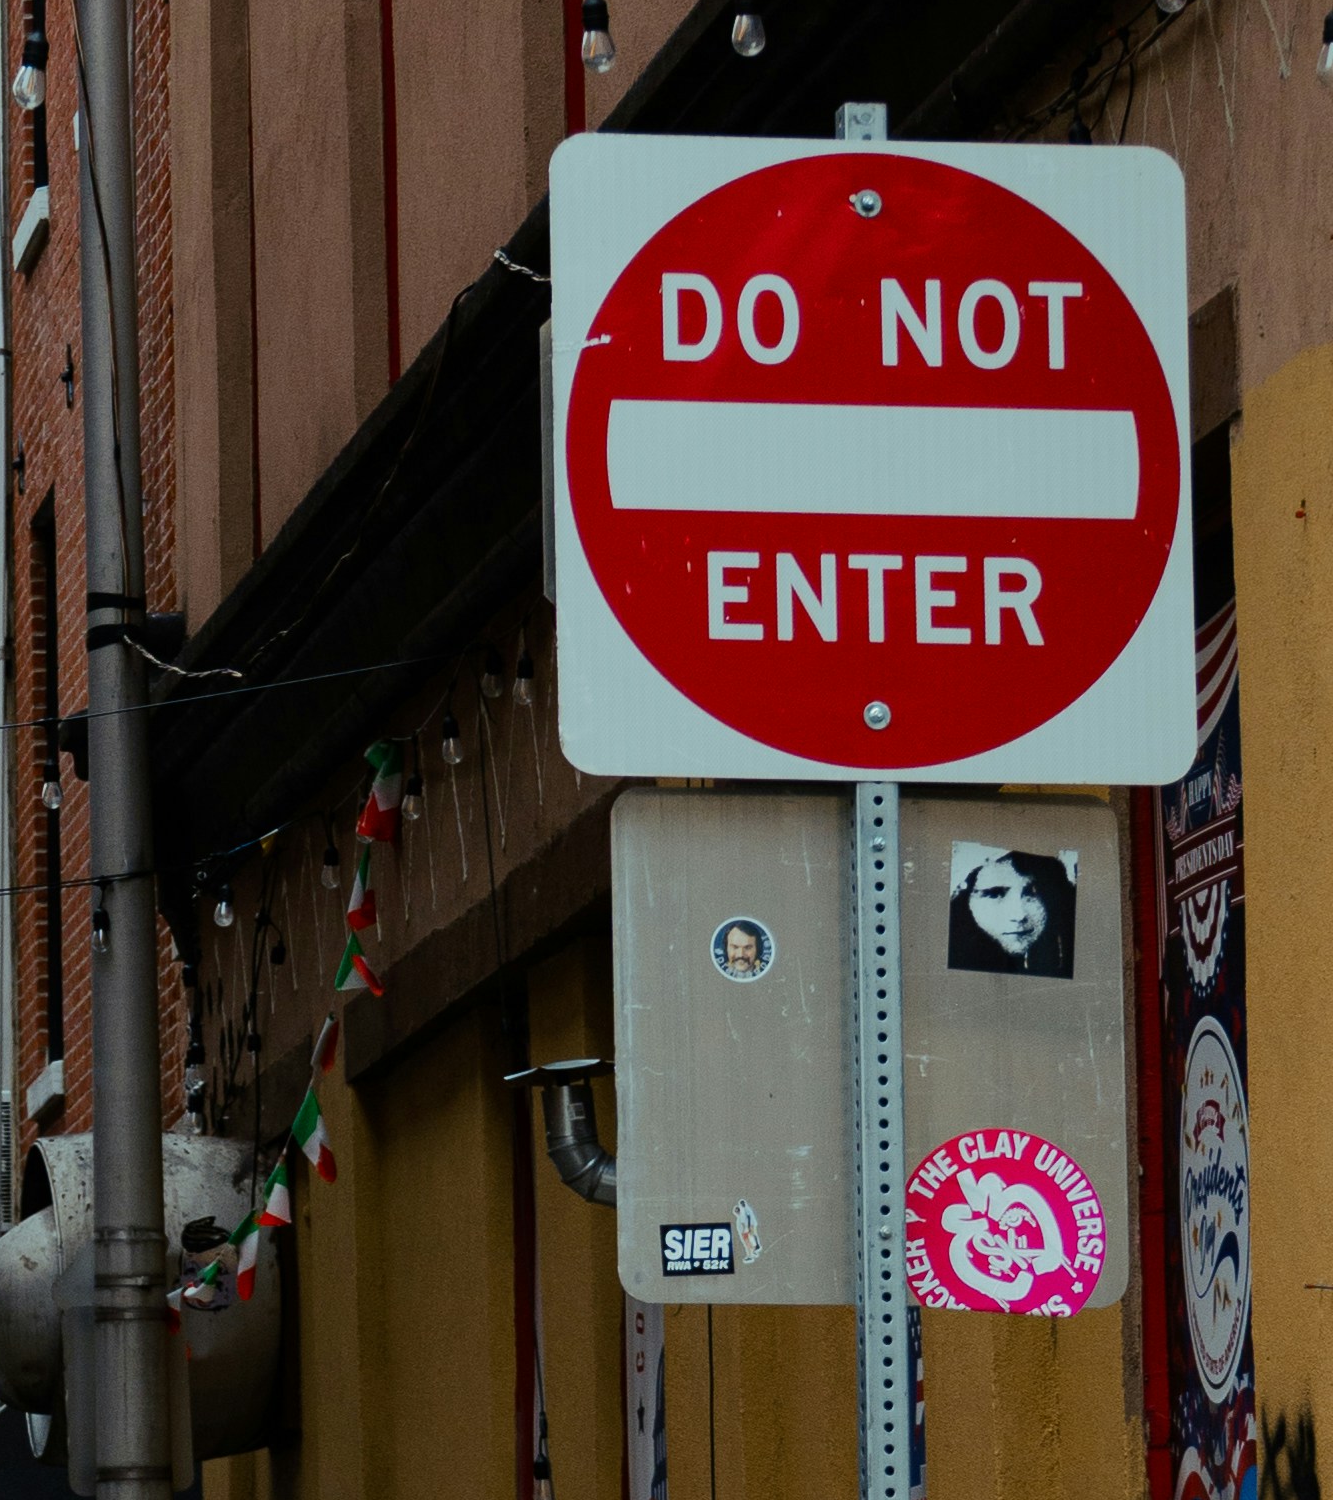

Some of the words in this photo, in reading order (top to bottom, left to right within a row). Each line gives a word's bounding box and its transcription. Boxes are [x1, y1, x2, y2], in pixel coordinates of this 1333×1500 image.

[661, 272, 801, 365] DO
[880, 278, 1084, 371] NOT
[706, 550, 1046, 647] ENTER
[663, 1228, 731, 1261] SIER
[908, 1148, 959, 1200] THE
[958, 1131, 1031, 1164] CLAY
[1034, 1143, 1104, 1275] UNIVERSE
